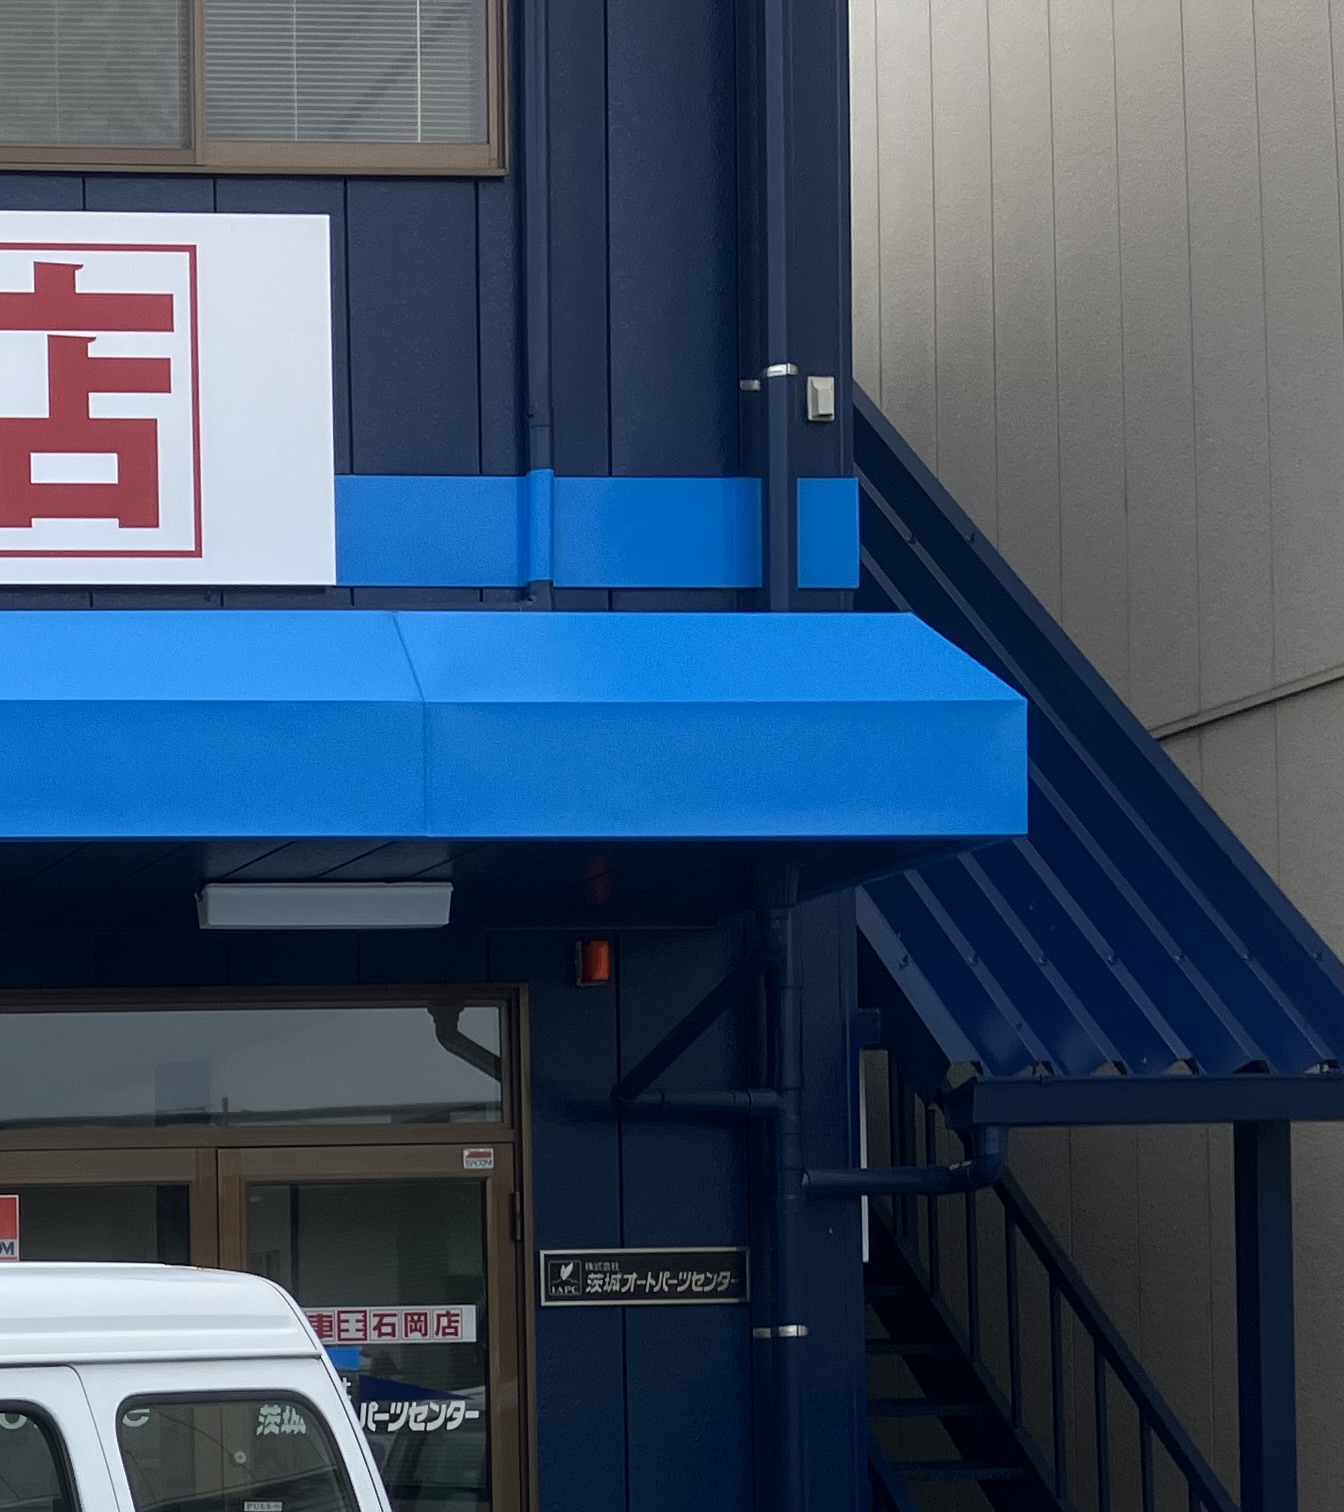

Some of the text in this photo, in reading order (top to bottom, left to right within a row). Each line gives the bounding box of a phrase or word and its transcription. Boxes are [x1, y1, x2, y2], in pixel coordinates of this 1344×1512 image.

[585, 1271, 740, 1294] 茨城オートパーツセンター
[358, 1400, 480, 1432] パーツセンター
